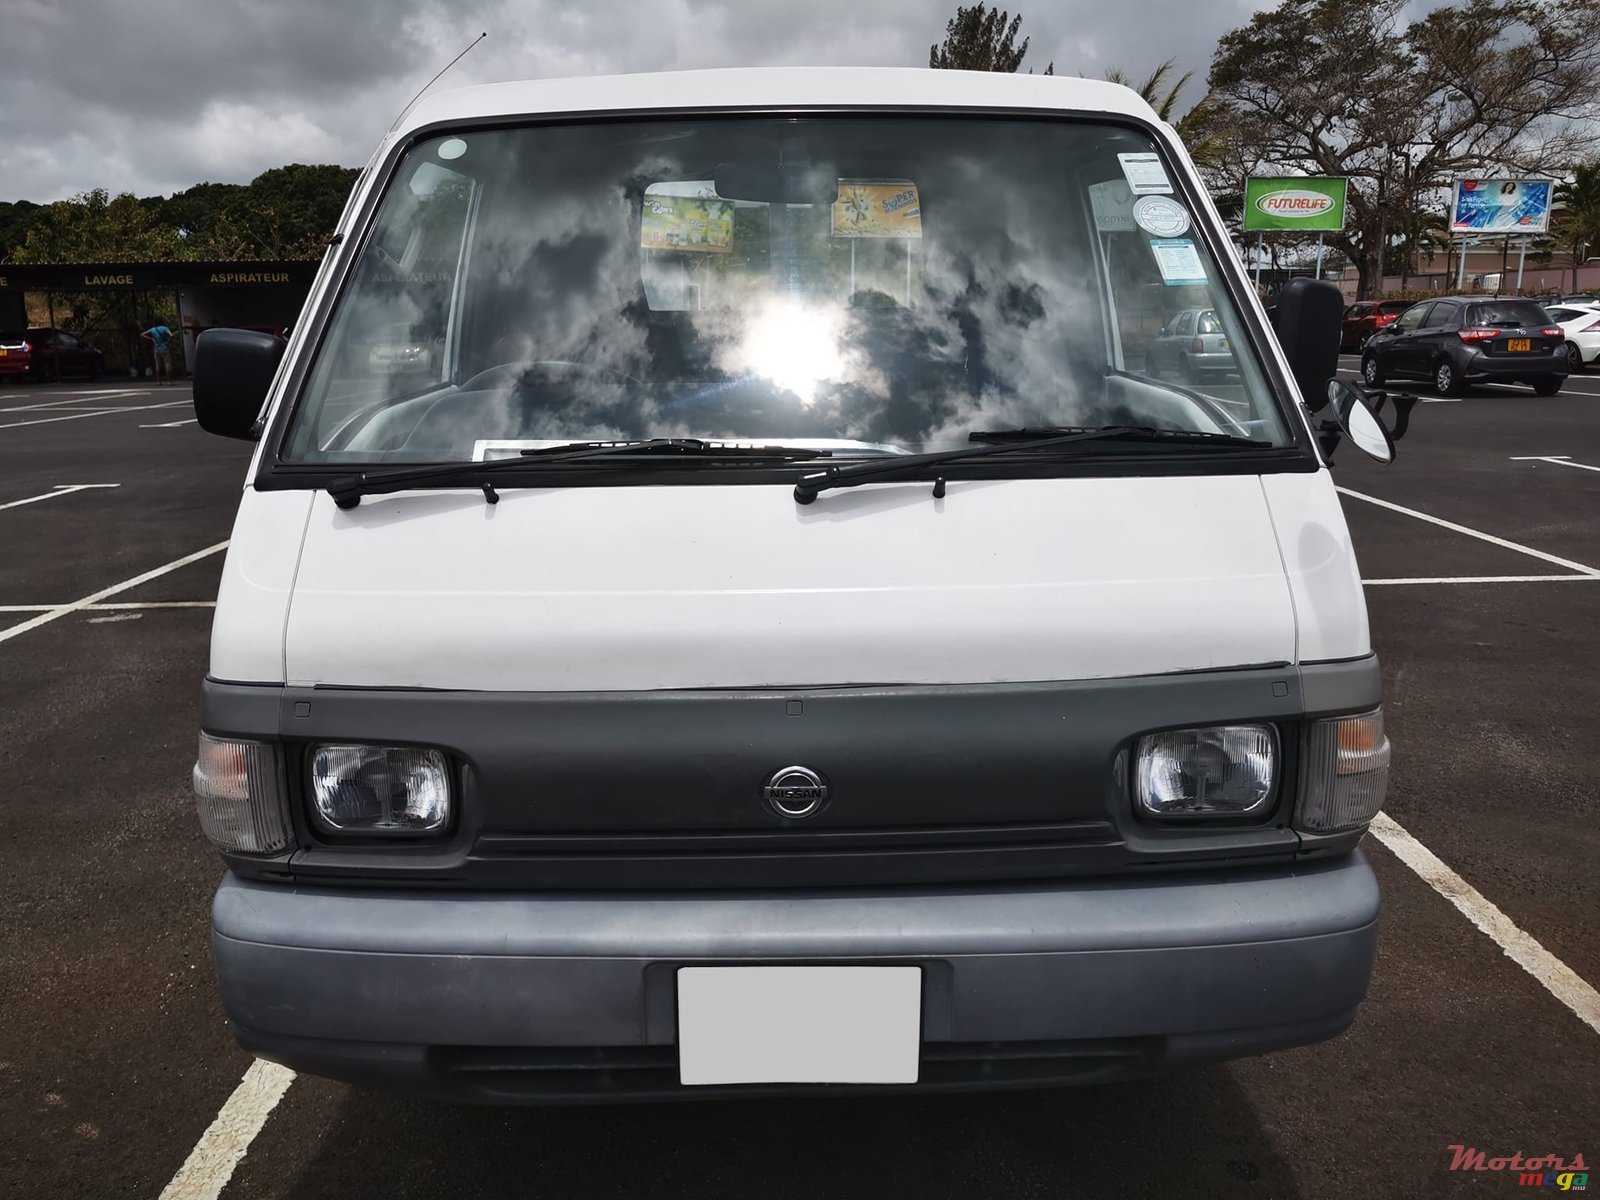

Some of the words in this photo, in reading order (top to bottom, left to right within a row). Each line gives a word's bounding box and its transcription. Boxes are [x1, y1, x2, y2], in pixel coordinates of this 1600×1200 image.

[882, 191, 914, 208] SUPER
[1267, 198, 1328, 209] FUTURELIFE
[84, 274, 134, 285] LAVAGE
[209, 272, 289, 283] ASPIRATEUR
[770, 789, 822, 799] NISSAN
